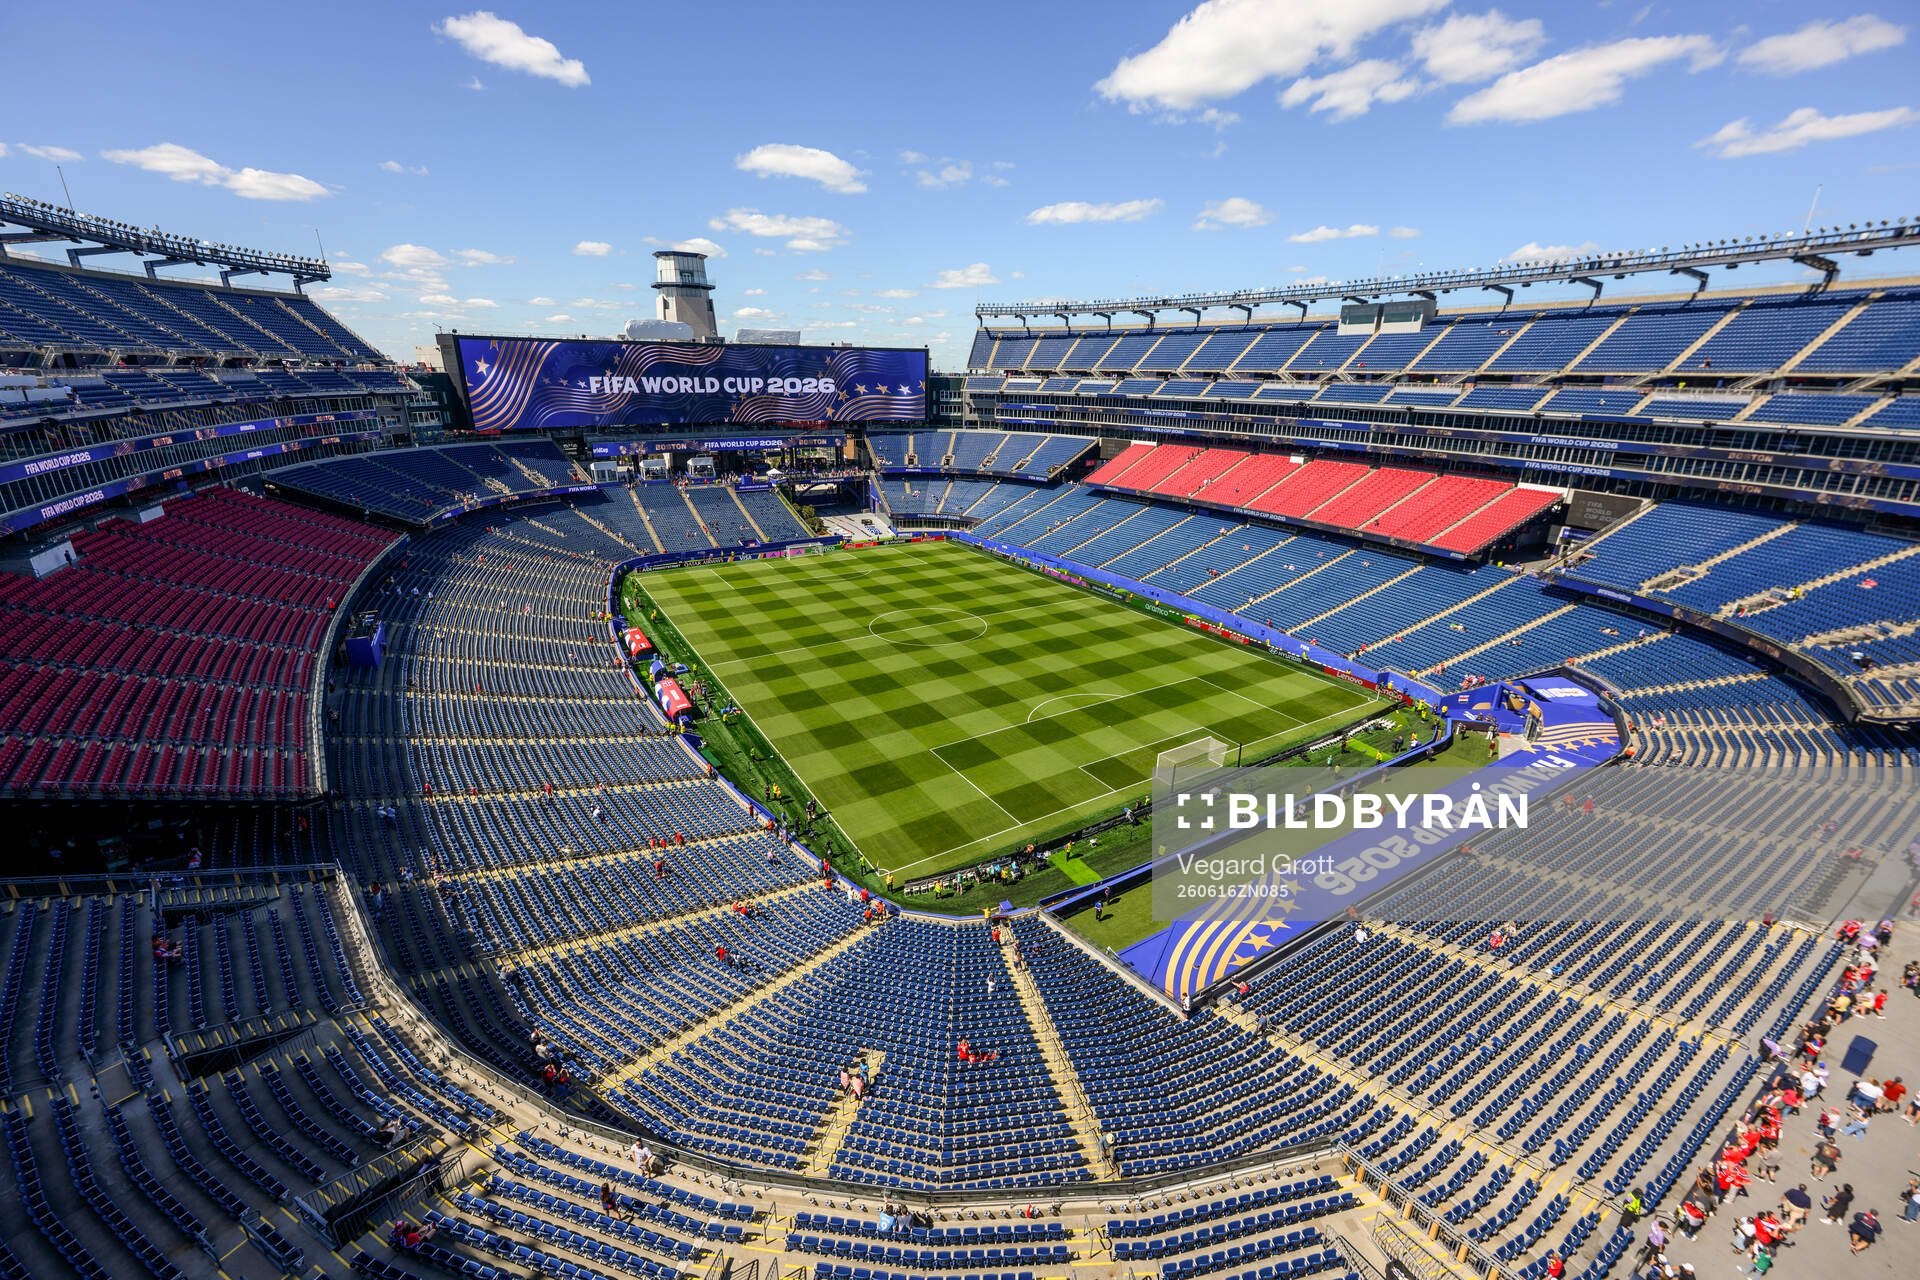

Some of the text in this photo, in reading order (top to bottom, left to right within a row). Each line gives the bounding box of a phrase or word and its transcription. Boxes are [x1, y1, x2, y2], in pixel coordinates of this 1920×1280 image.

[589, 376, 836, 394] FIFA WORLD CUP 2026
[1547, 438, 1574, 446] WORLD
[1574, 440, 1590, 448] CUP
[1590, 441, 1618, 450] 2026
[24, 452, 92, 475] FIFA WORLD CUP 2026
[1541, 462, 1567, 472] WORLD
[1568, 464, 1583, 473] CUP
[1583, 468, 1611, 476] 2026
[41, 490, 104, 519] FIFA WORLD CUP 2026
[1144, 603, 1169, 616] aramco
[1278, 652, 1303, 663] HYUNDAI
[1336, 672, 1364, 686] Lenovo
[1516, 754, 1577, 782] FIFA
[1314, 834, 1420, 896] 2026
